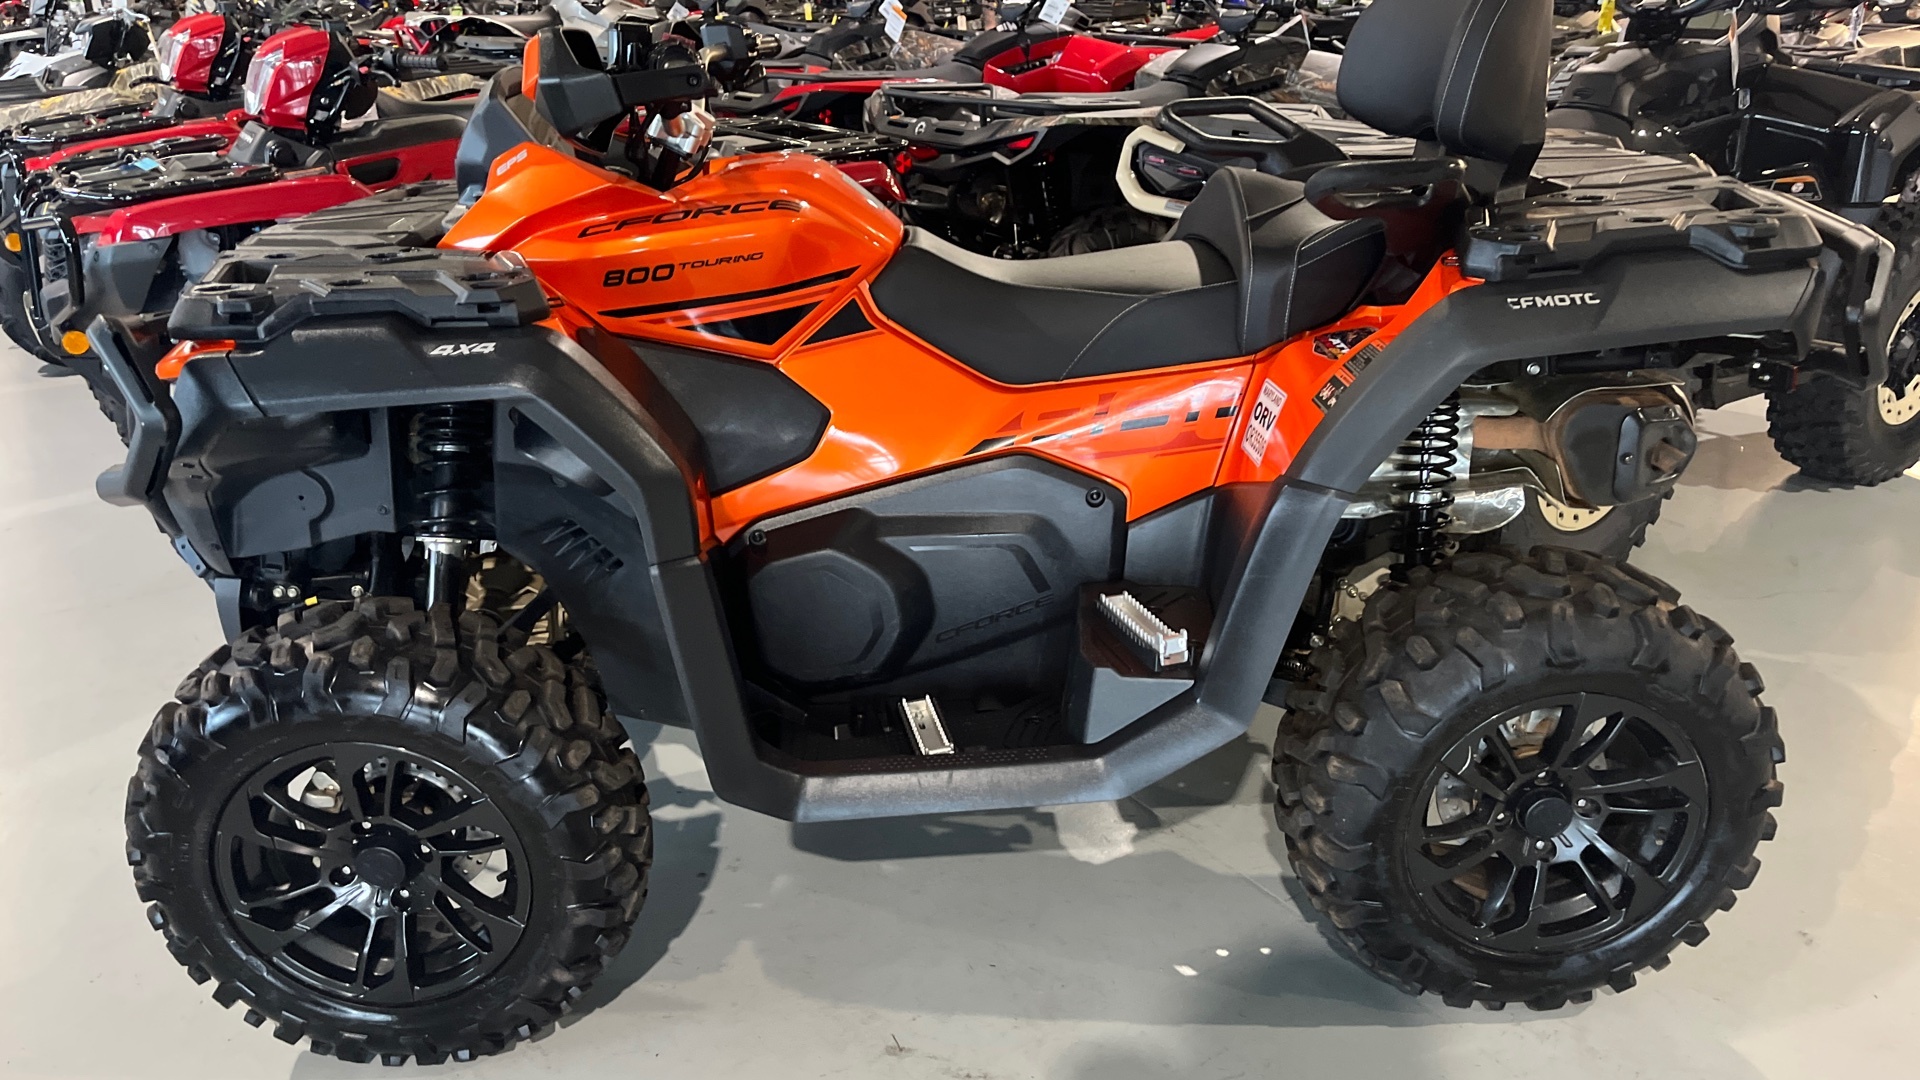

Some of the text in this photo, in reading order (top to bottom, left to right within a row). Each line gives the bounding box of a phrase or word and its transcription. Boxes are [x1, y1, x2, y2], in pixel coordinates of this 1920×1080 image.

[496, 149, 528, 177] EPS
[577, 199, 801, 238] CFORCE
[602, 252, 764, 287] 800 TOURING
[1254, 401, 1276, 431] ORV
[936, 593, 1055, 644] CFORCE
